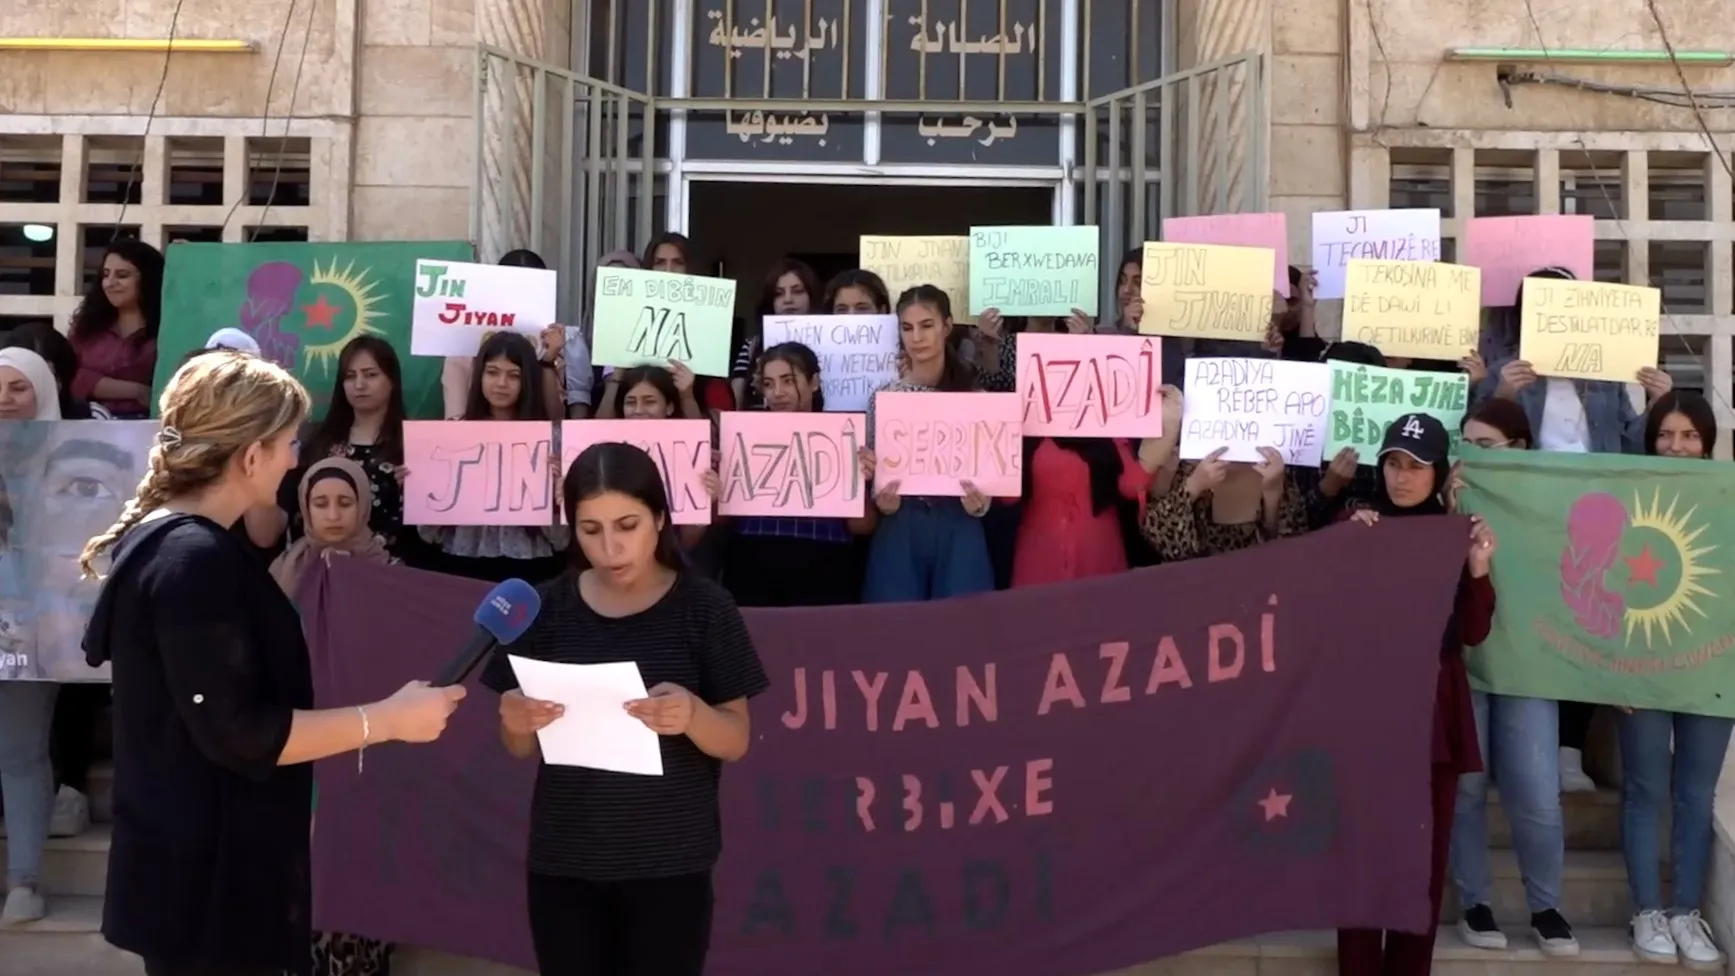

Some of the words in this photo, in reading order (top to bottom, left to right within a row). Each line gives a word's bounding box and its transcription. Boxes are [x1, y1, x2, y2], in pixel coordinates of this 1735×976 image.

[707, 10, 837, 59] الرياضية
[909, 15, 1035, 54] الصالة
[726, 109, 829, 147] بضيوفها
[1345, 215, 1367, 234] JI
[985, 252, 1097, 270] BERXWEDANA
[1145, 247, 1207, 287] JIN
[417, 264, 466, 298] JIN
[602, 275, 634, 297] EM
[1448, 269, 1473, 294] ME
[1534, 286, 1554, 307] JI
[438, 303, 516, 327] JIYAN
[1169, 290, 1254, 332] JIYAN
[626, 305, 693, 362] NA
[831, 324, 882, 346] CIWAN
[1554, 343, 1603, 373] NA
[1022, 339, 1153, 430] AZADÎ
[1333, 366, 1404, 404] HÊZA
[1284, 391, 1325, 417] APO
[1400, 415, 1425, 440] LA
[722, 418, 860, 508] AZADÎ
[882, 419, 1020, 479] SERBIXE
[427, 440, 550, 512] JIN
[781, 662, 998, 732] JIYAN
